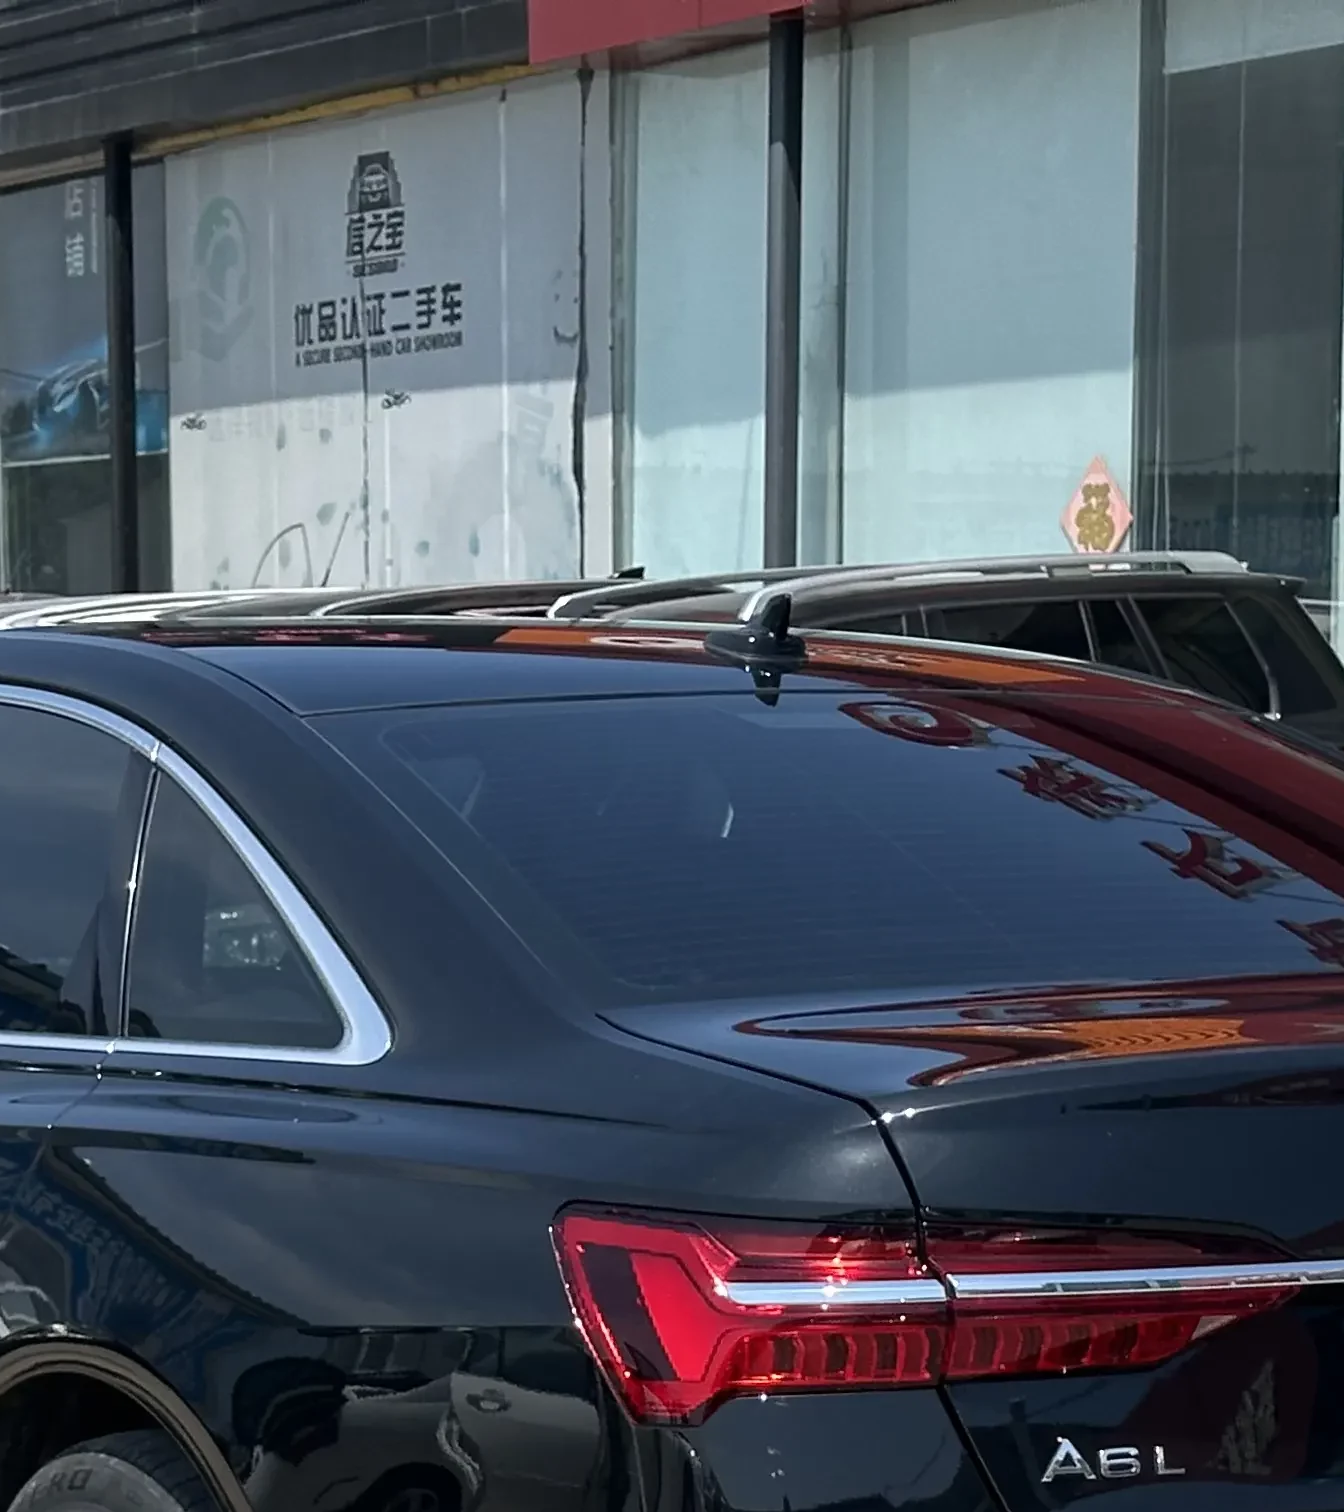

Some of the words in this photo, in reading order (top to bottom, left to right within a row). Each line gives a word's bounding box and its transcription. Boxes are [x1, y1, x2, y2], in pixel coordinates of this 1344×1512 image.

[293, 282, 463, 347] 优品认证二手车
